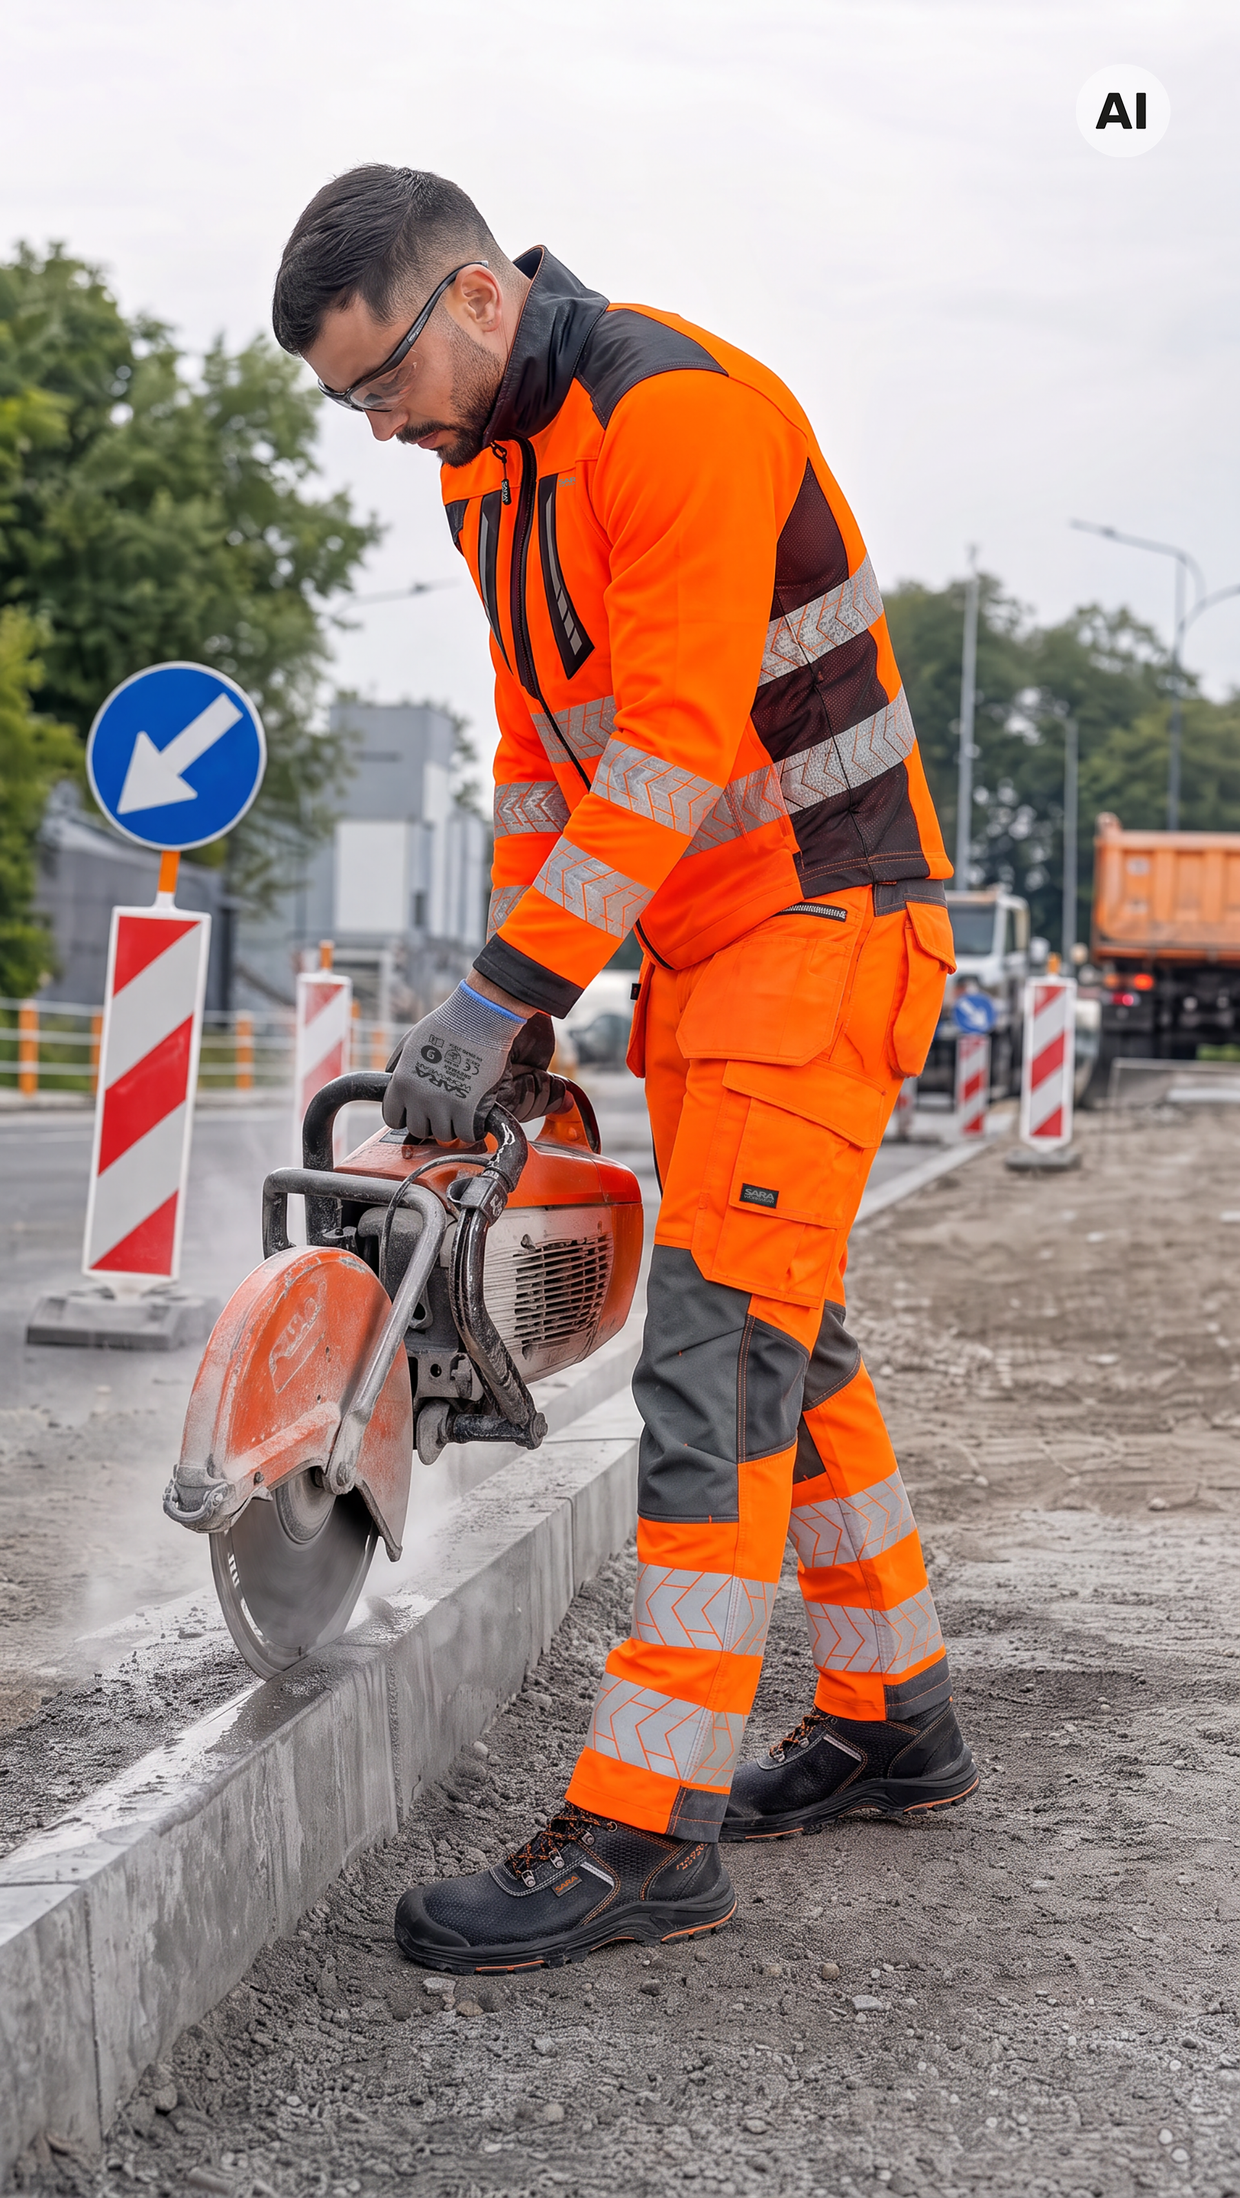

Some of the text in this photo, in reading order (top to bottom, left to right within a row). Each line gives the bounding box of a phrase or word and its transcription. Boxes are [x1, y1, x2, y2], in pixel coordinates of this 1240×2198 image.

[414, 1065, 470, 1099] SARA
[416, 1060, 472, 1091] WORKWEAR
[744, 1188, 775, 1201] SARA
[554, 1875, 579, 1894] SARA
